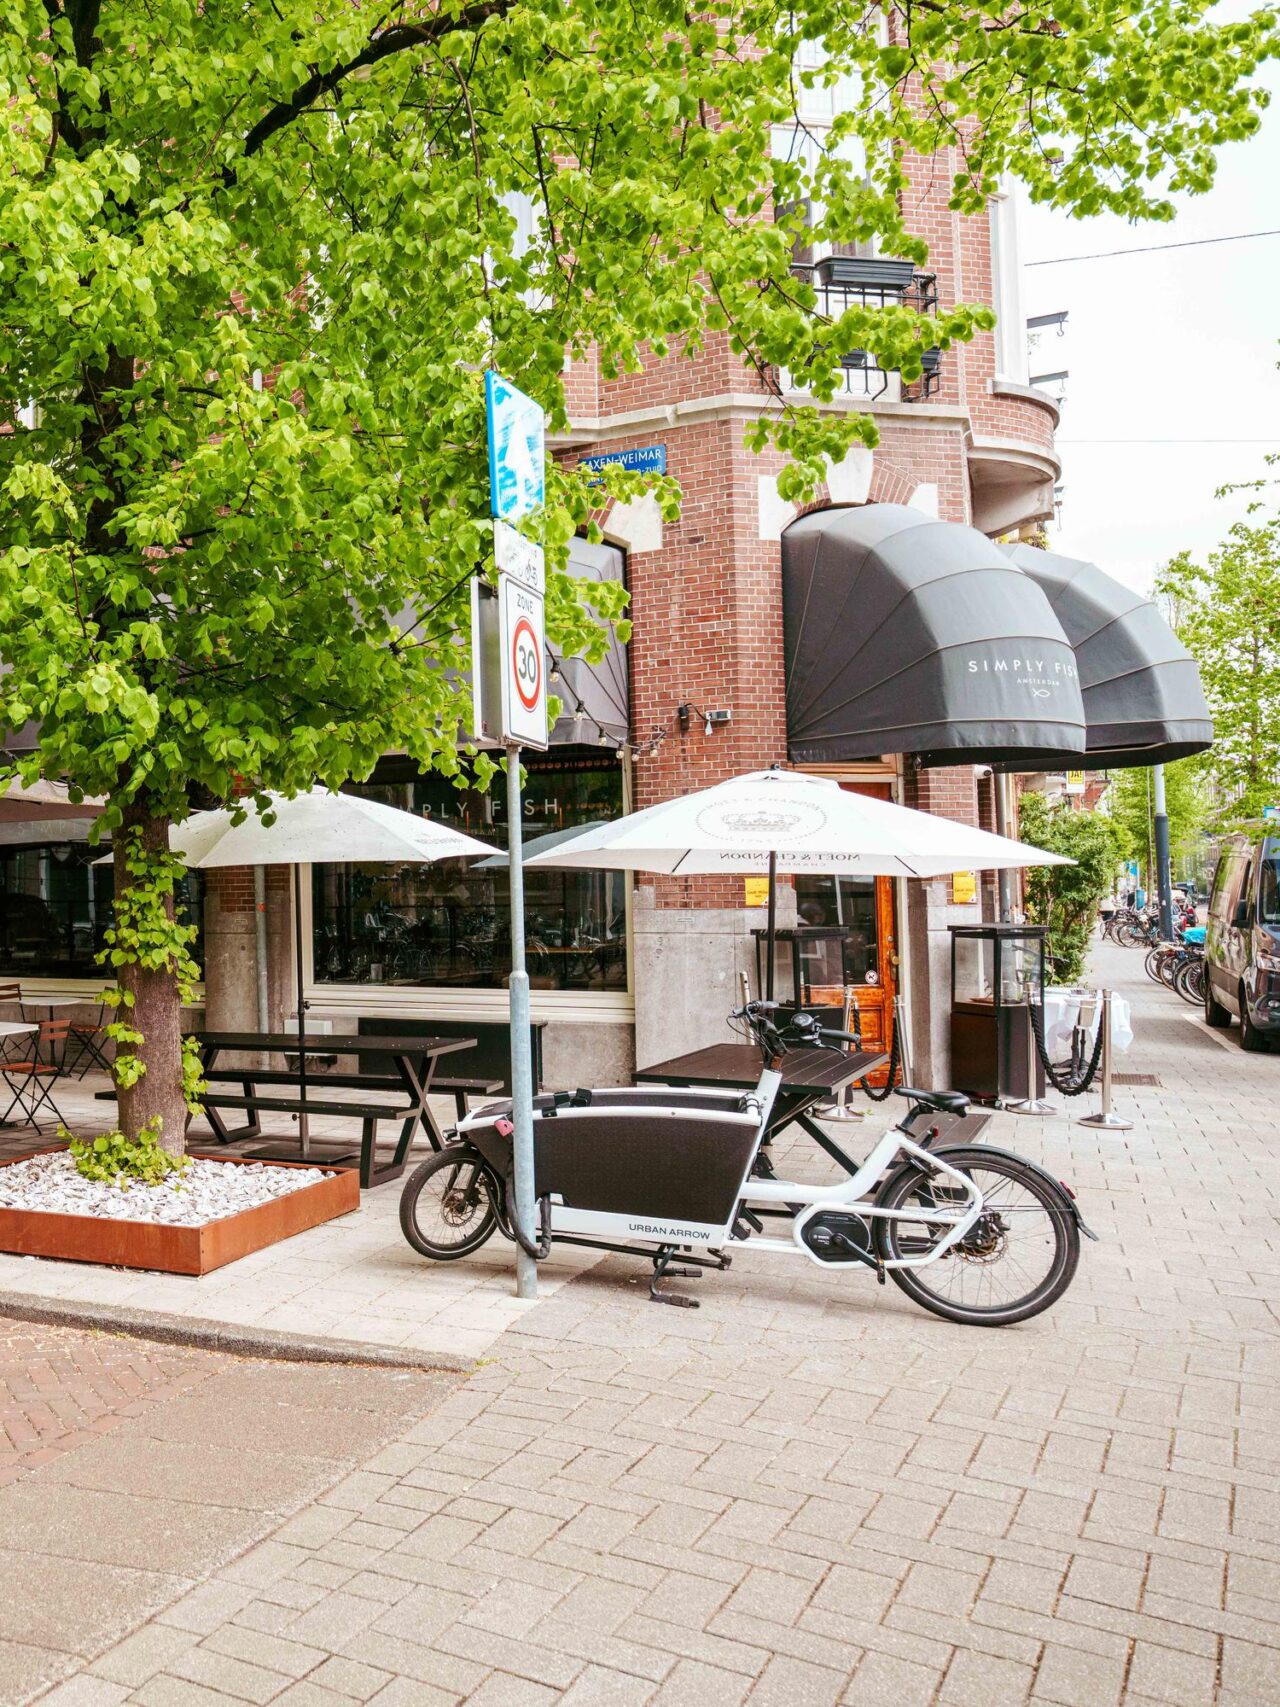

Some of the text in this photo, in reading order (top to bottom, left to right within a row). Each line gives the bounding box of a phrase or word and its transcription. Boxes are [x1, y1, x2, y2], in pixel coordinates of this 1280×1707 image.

[584, 448, 662, 470] AXEN-WEIMAR
[517, 593, 534, 615] ZONE
[518, 645, 536, 683] 30
[968, 659, 1044, 673] SIMPLY
[1016, 678, 1059, 686] AMSTERDAM
[1071, 769, 1082, 778] JA!
[490, 798, 558, 817] FSH
[629, 1223, 711, 1240] URBAN ARROW
